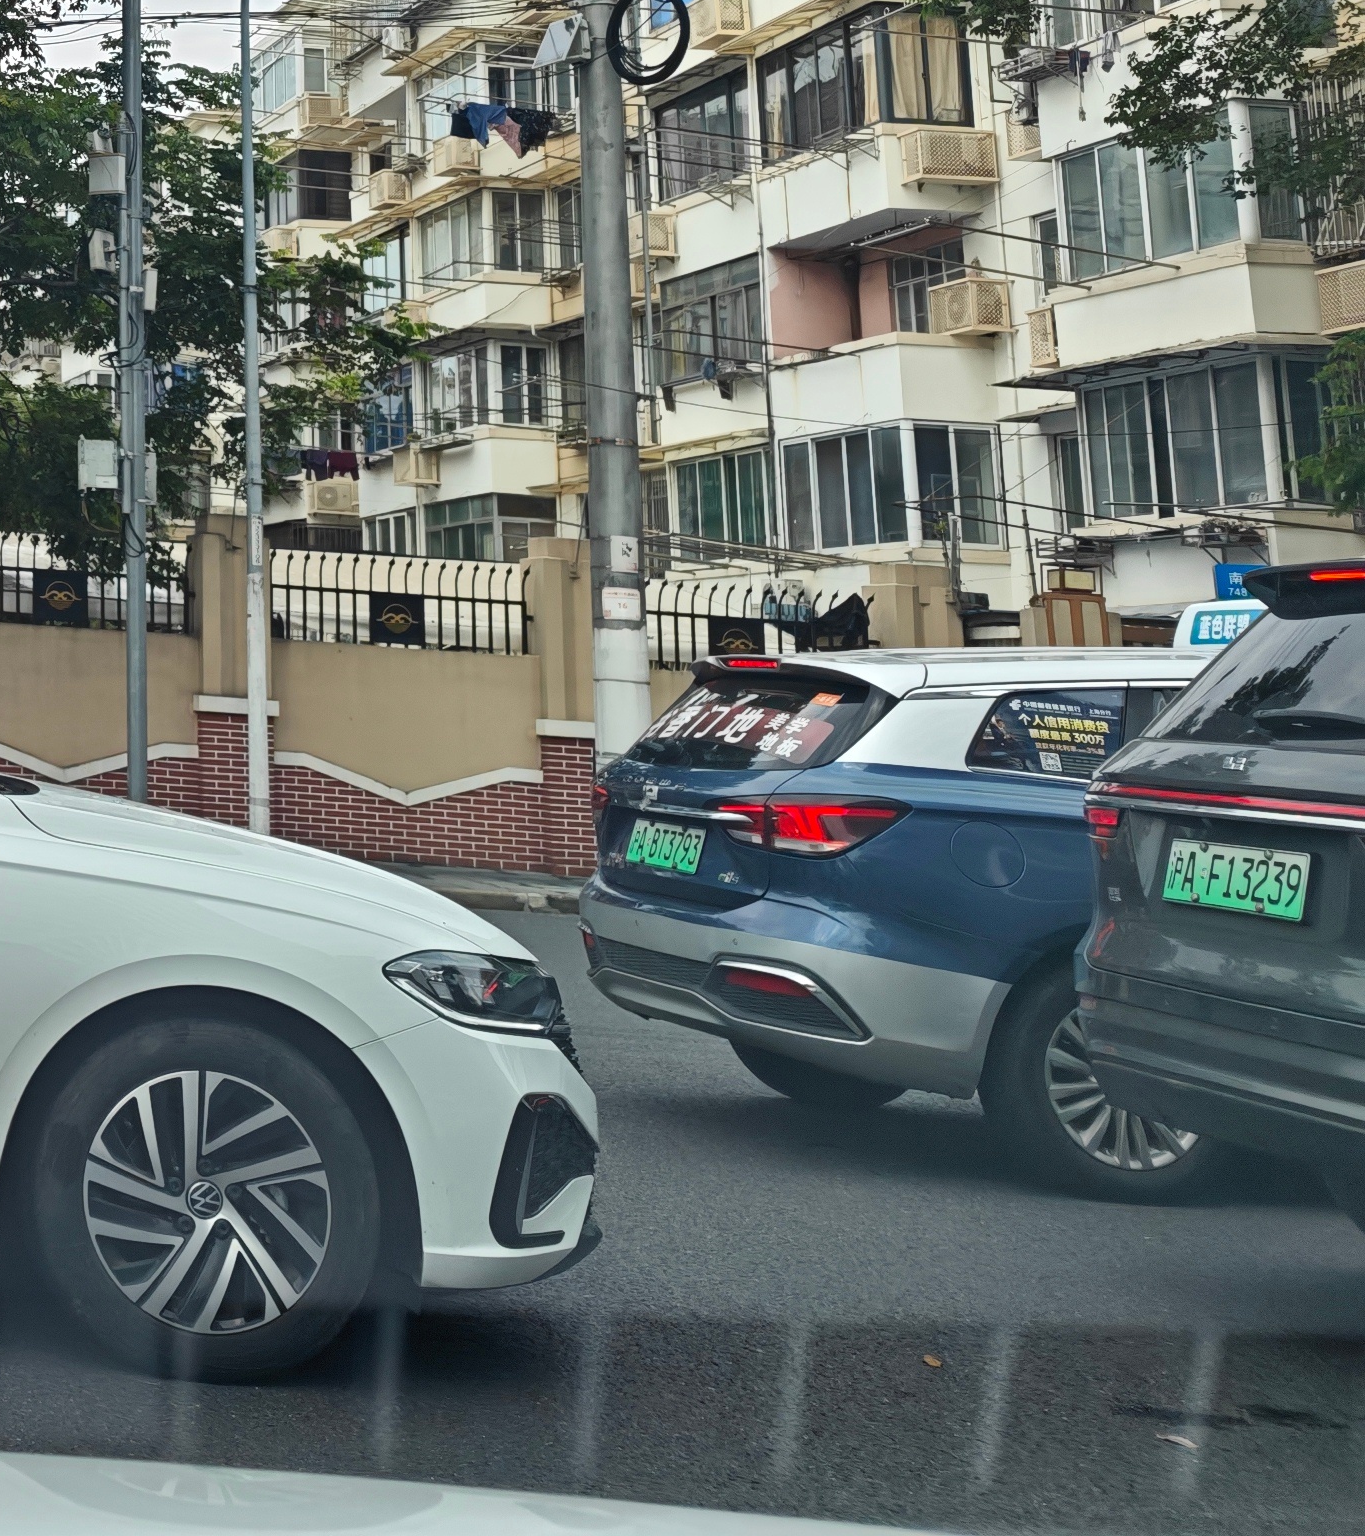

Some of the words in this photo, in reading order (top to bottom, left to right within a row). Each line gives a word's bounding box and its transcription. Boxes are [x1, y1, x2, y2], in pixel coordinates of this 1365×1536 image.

[1198, 613, 1251, 641] 蓝色联盟
[764, 712, 810, 735] 美学
[1018, 713, 1110, 734] 个人信用消费贷
[755, 731, 803, 758] 地板
